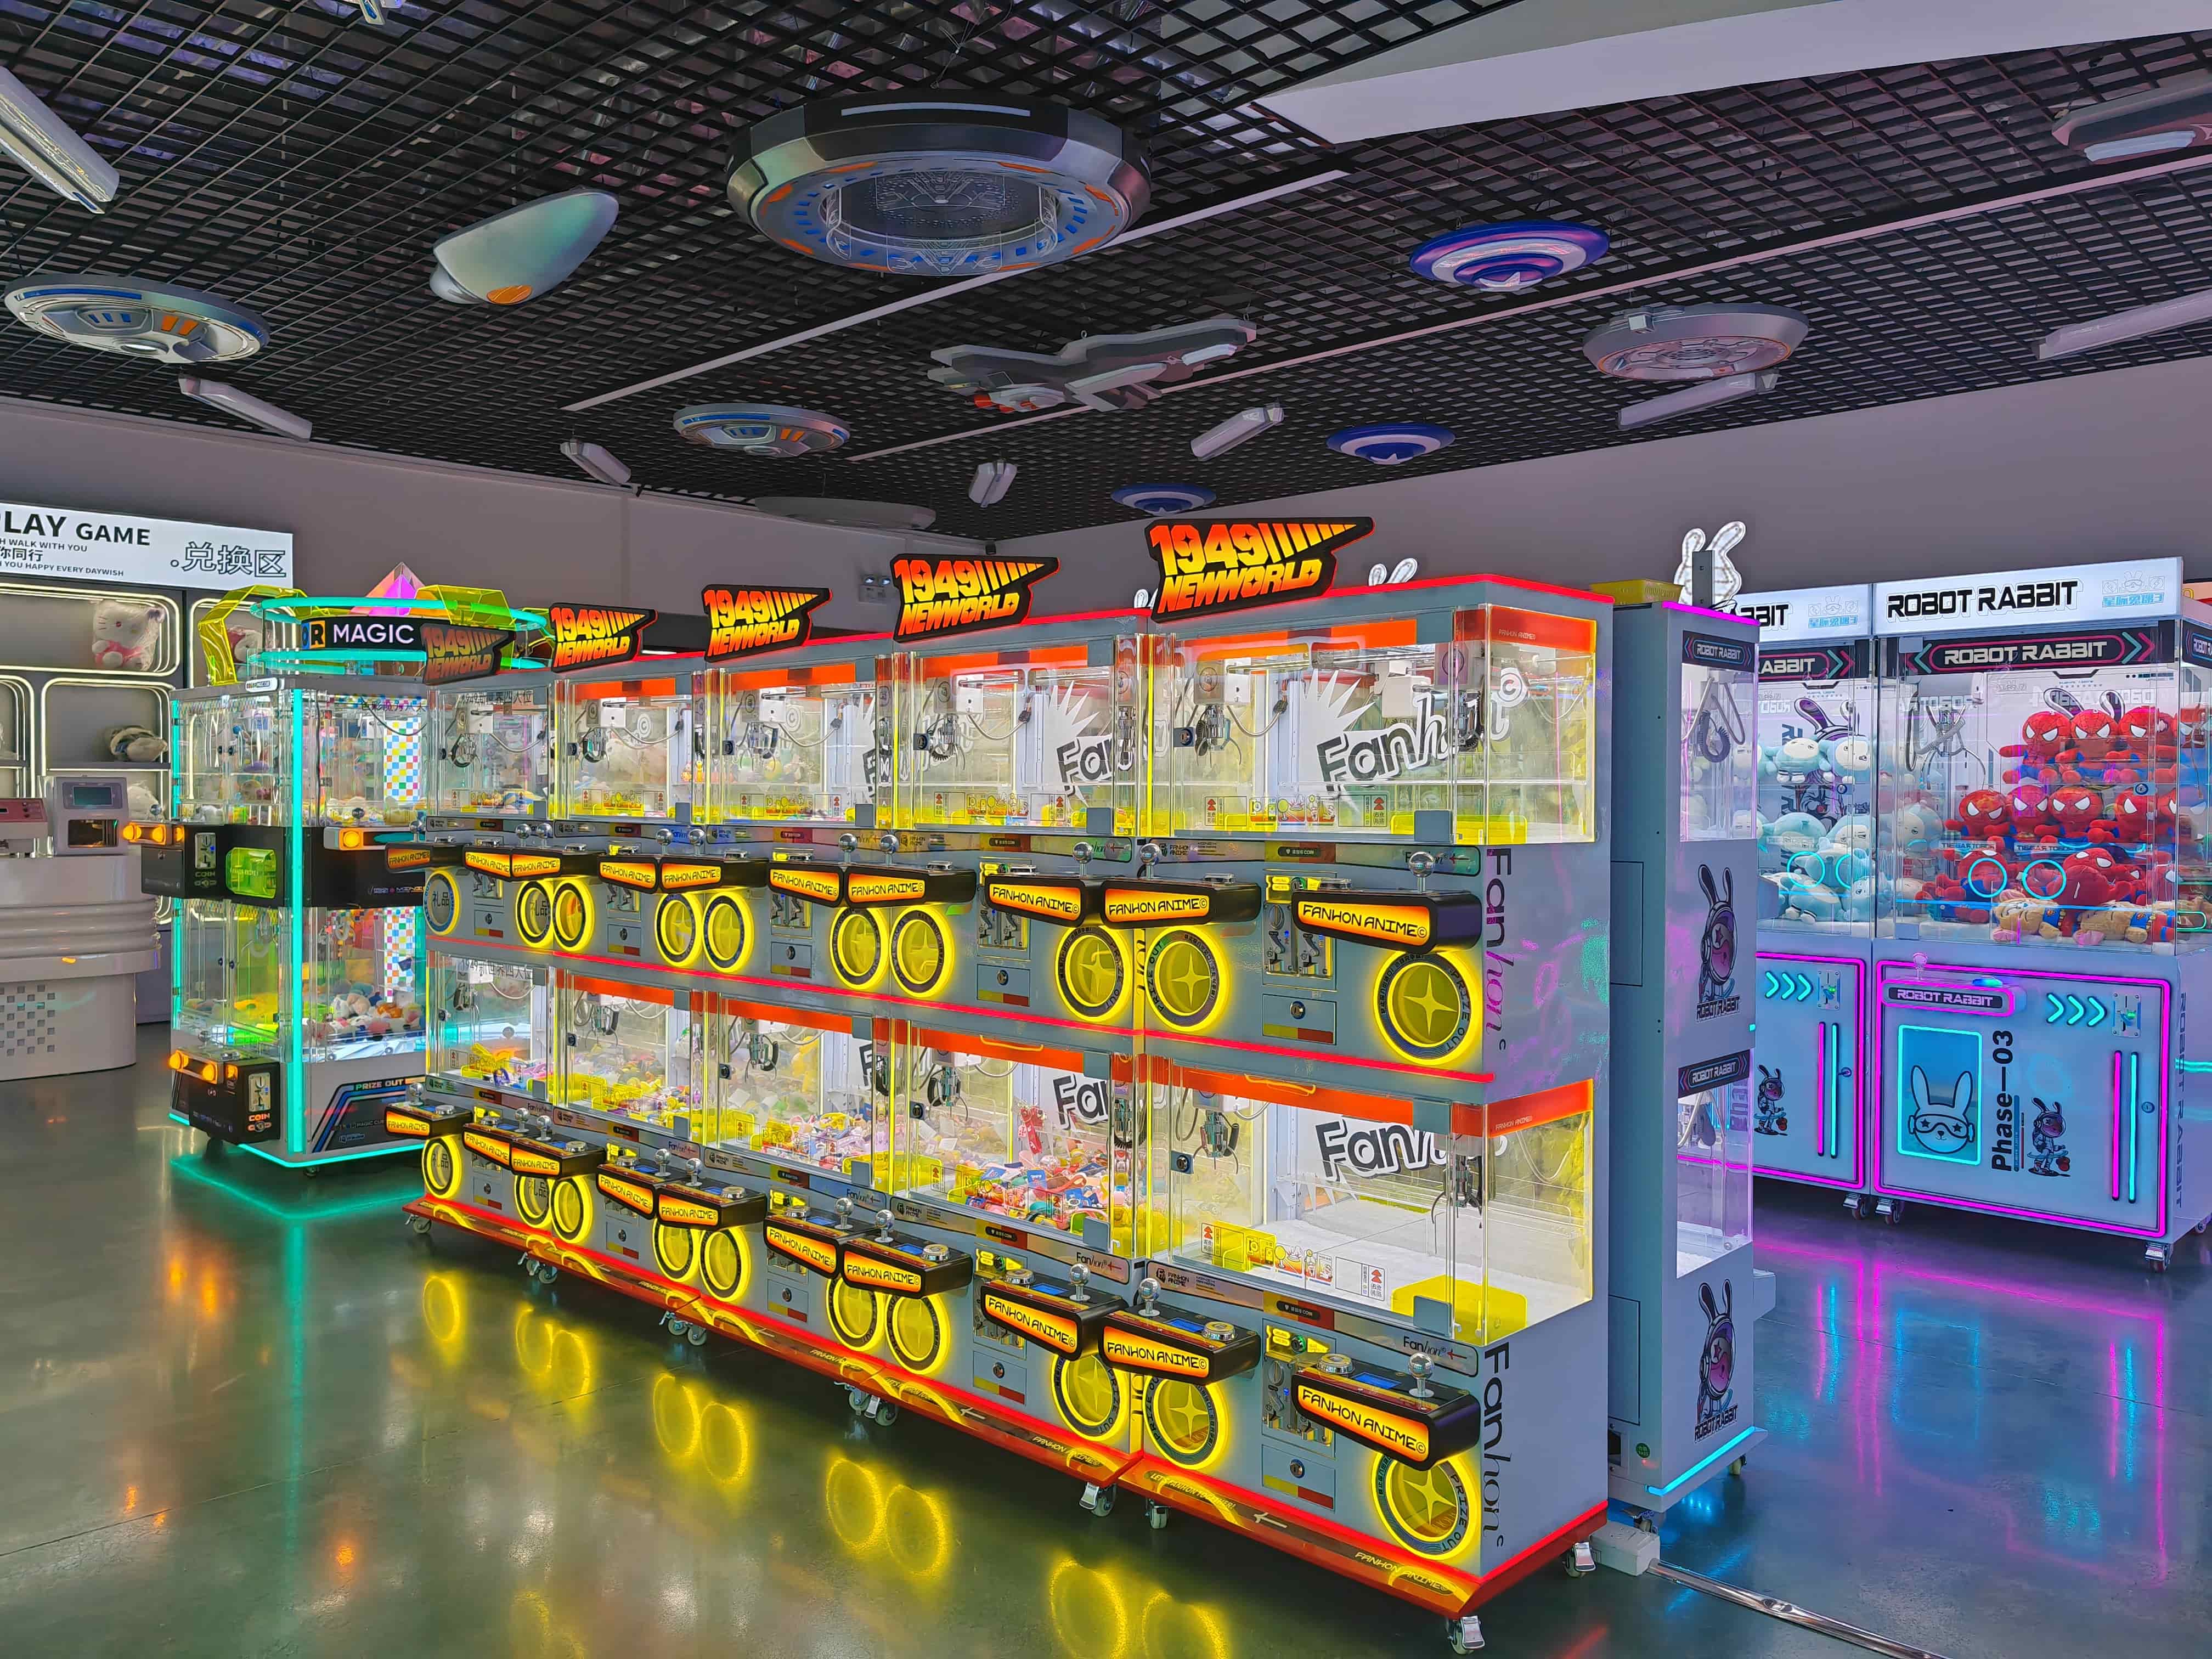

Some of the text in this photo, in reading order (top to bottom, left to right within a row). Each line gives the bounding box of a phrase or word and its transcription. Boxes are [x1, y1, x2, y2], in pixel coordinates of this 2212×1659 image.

[0, 511, 150, 545] LAY GAME
[9, 539, 37, 548] WALK
[39, 541, 64, 550] WITH
[25, 563, 54, 572] HAPPY
[57, 565, 83, 574] EVERY
[86, 567, 124, 576] DAYWISH
[1888, 589, 1973, 618] ROBOT
[1978, 581, 2078, 612] RABBIT
[334, 623, 414, 644] MAGIC
[1696, 644, 1741, 660] ROBOT RABBIT
[1944, 641, 2107, 665] ROBOT RABBIT
[1759, 658, 1815, 674] ABBIT
[432, 891, 450, 907] 礼品
[851, 884, 887, 896] FANHON
[992, 887, 1034, 905] FANHON
[1109, 901, 1157, 915] FANHON
[1303, 904, 1362, 926] FANHON
[1897, 989, 1993, 1006] ROBOT RABBIT
[1447, 1027, 1465, 1052] OUT
[356, 1079, 405, 1091] PRIZE OUT
[1691, 1069, 1713, 1085] ROBOT
[2176, 992, 2186, 1209] ROBOT RABBIT
[249, 1113, 270, 1122] COIN
[769, 1229, 800, 1251] FANHON
[847, 1265, 882, 1278] FANHON
[989, 1298, 1030, 1325] FANHON
[1108, 1342, 1156, 1362] FANHON
[1302, 1390, 1362, 1426] FANHON
[1483, 1341, 1512, 1541] Fanhon
[1442, 1474, 1468, 1552] PRIZE OUT
[1355, 1551, 1402, 1573] FANHON
